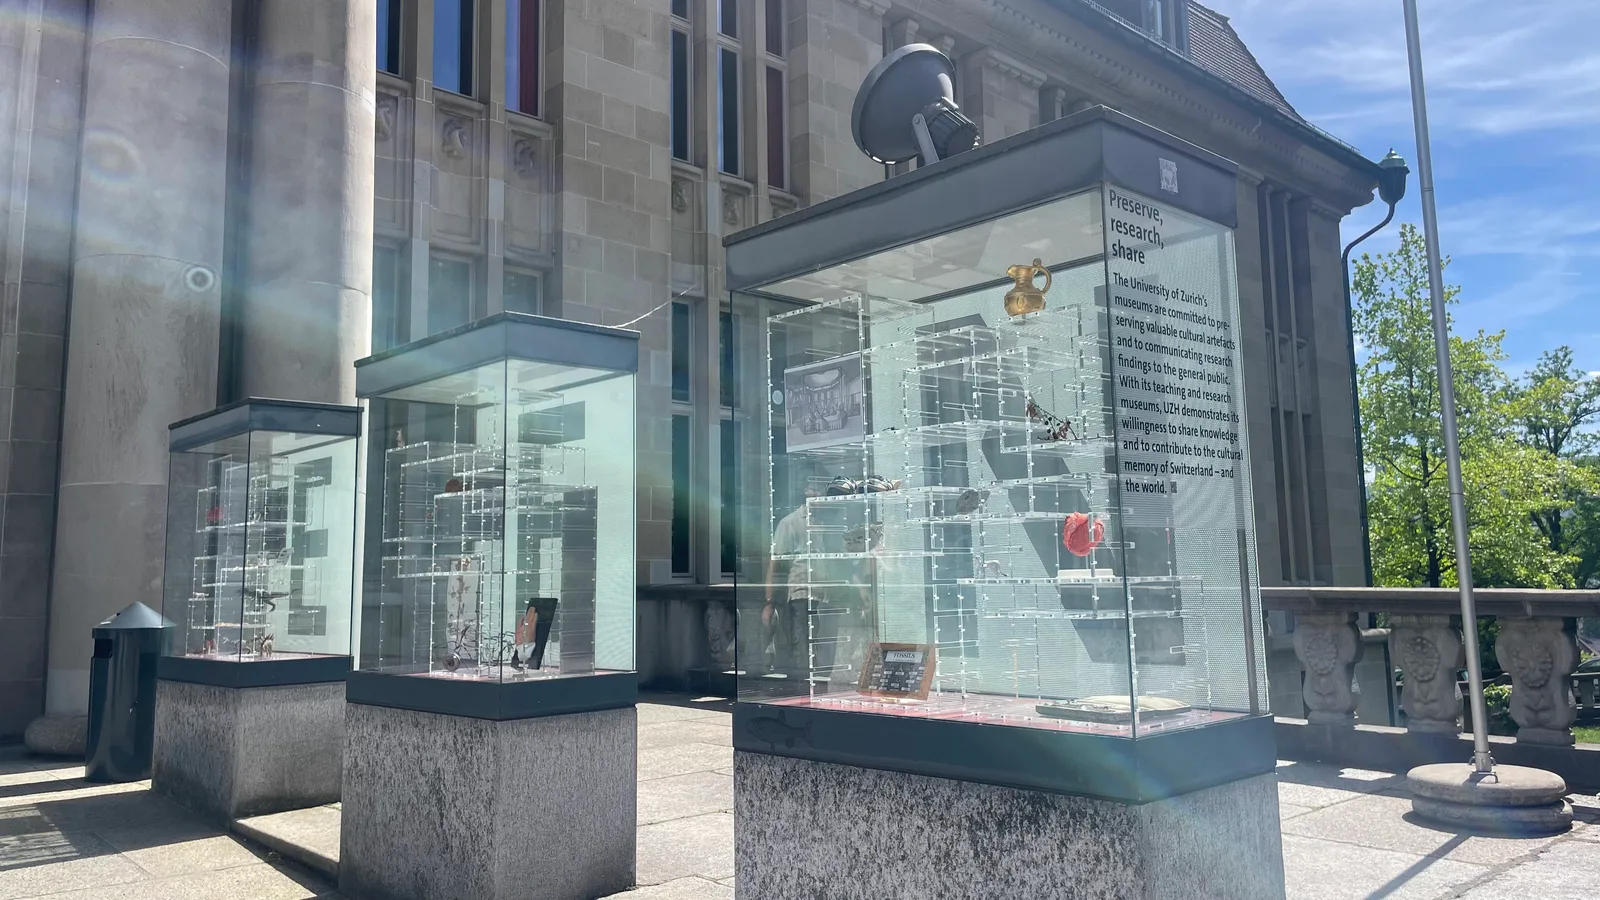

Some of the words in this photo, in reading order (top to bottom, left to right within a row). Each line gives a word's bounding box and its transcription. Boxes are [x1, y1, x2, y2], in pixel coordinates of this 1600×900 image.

[1109, 189, 1163, 226] Preserve,
[1111, 217, 1164, 249] research,
[1112, 239, 1145, 264] share
[1113, 272, 1129, 288] The
[1130, 276, 1170, 301] University
[1171, 288, 1180, 300] of
[1181, 290, 1208, 307] Zurich's
[1114, 295, 1153, 313] museums
[1154, 305, 1166, 316] are
[1168, 307, 1206, 325] committed
[1207, 316, 1216, 327] to
[1216, 320, 1230, 332] pre-
[1116, 316, 1145, 334] serving
[1146, 321, 1178, 338] valuable
[1179, 328, 1206, 344] cultural
[1207, 335, 1236, 350] artefacts
[1117, 335, 1132, 348] and
[1134, 338, 1143, 350] to
[1144, 342, 1203, 365] communicating
[1204, 354, 1233, 368] research
[1118, 354, 1152, 374] findings
[1153, 361, 1162, 373] to
[1163, 362, 1177, 376] the
[1178, 368, 1206, 381] general
[1207, 372, 1231, 385] public.
[1119, 374, 1140, 389] With
[1141, 378, 1152, 391] its
[1153, 381, 1187, 400] teaching
[1187, 387, 1201, 399] and
[1202, 391, 1232, 404] research
[1120, 398, 1162, 415] museums,
[1163, 402, 1180, 415] UZH
[1181, 407, 1230, 422] demonstrates
[1231, 411, 1240, 423] its
[1122, 417, 1167, 435] willingness
[1168, 422, 1177, 435] to
[1178, 423, 1199, 437] share
[1200, 425, 1238, 445] knowledge
[1123, 438, 1139, 451] and
[1141, 439, 1150, 452] to
[1152, 441, 1192, 456] contribute
[1193, 445, 1202, 457] to
[1203, 445, 1216, 458] the
[1217, 447, 1243, 460] cultural
[1124, 461, 1159, 476] memory
[1160, 461, 1169, 474] of
[1170, 462, 1213, 477] Switzerland
[1221, 467, 1234, 479] and
[1125, 479, 1140, 493] the
[1141, 480, 1167, 494] world.
